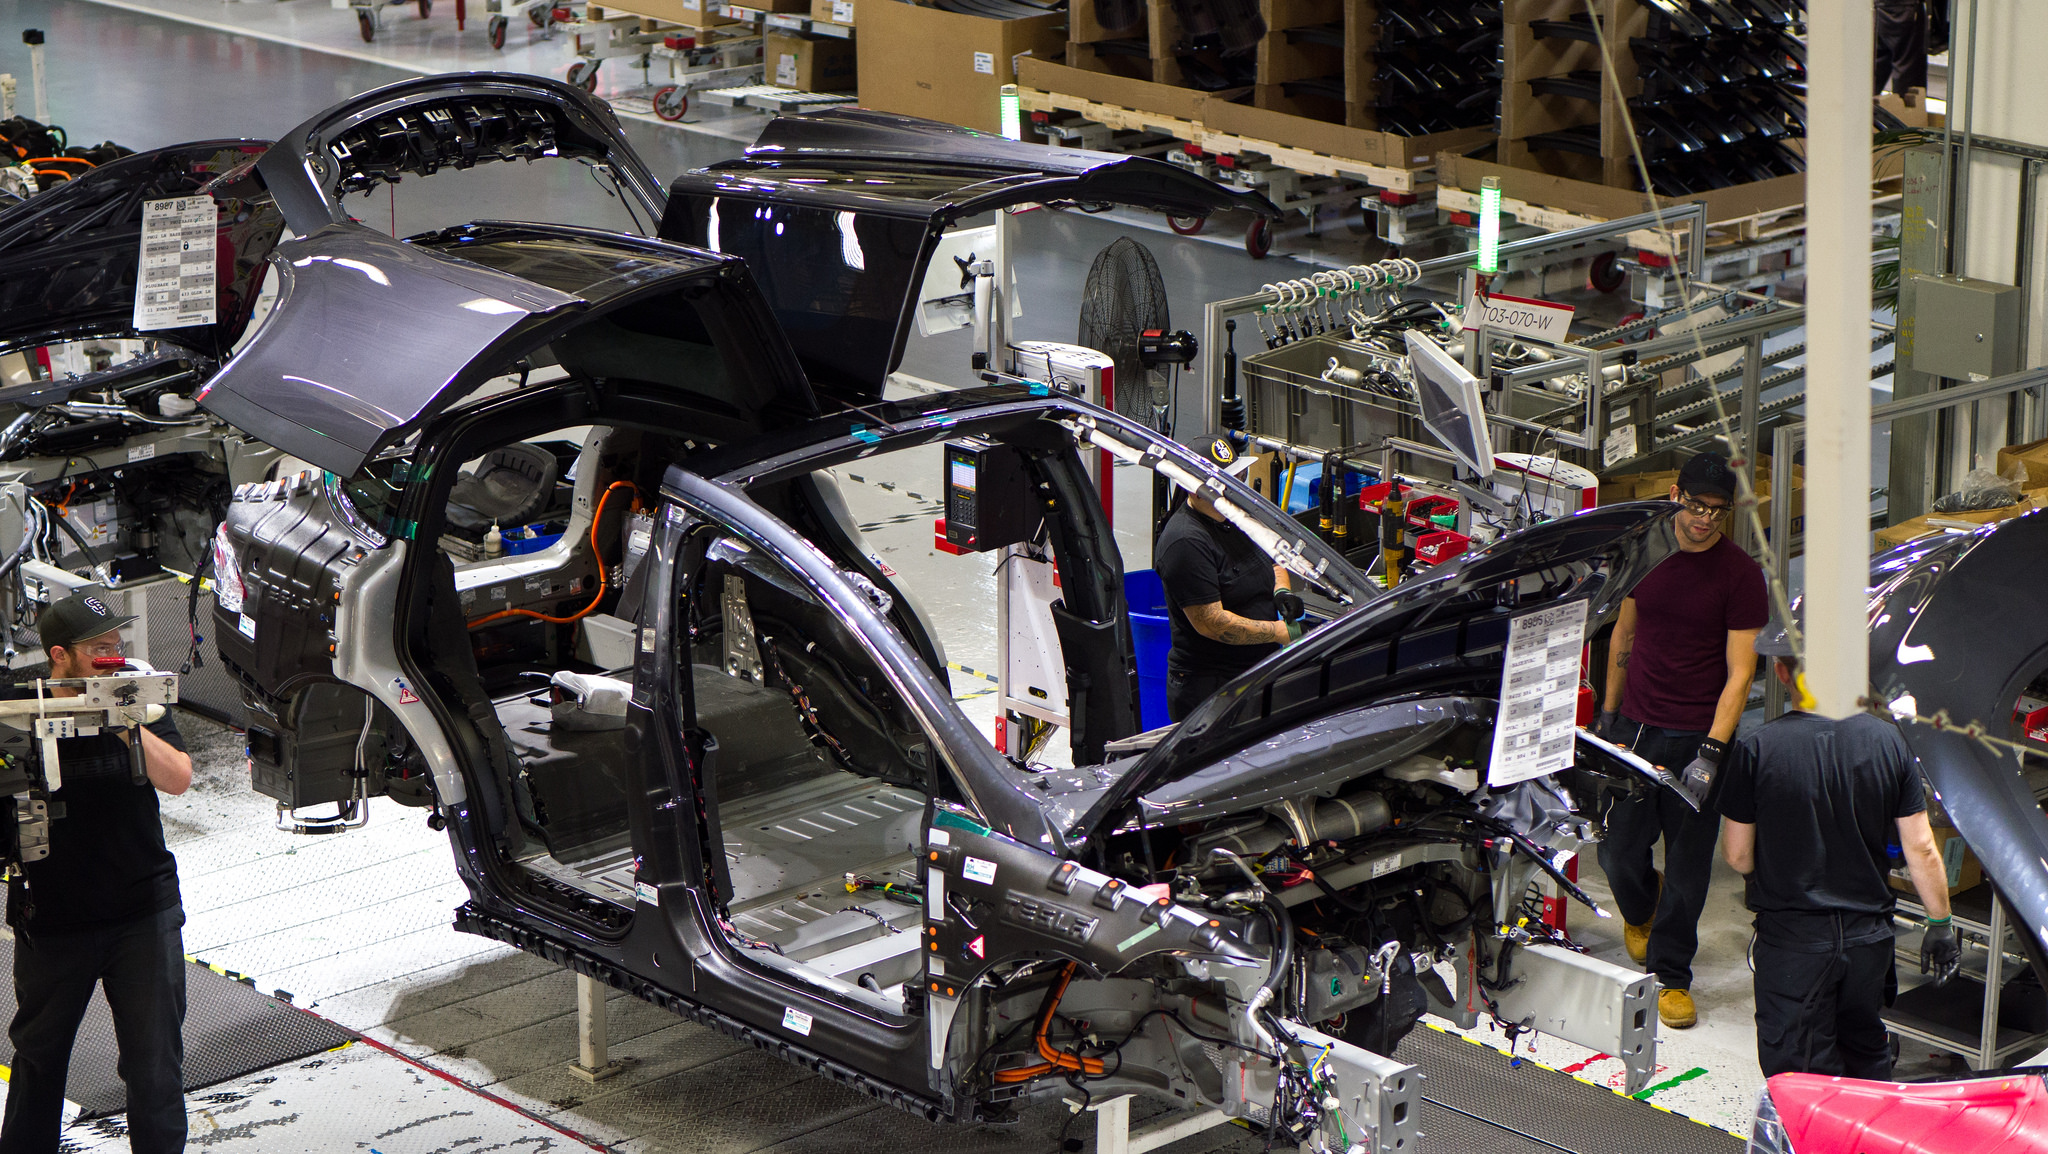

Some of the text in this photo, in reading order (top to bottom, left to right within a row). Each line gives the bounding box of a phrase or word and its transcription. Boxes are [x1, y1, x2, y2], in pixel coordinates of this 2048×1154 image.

[1481, 306, 1554, 330] T03-070-W
[68, 753, 129, 776] TESL
[1004, 895, 1095, 940] TESLA
